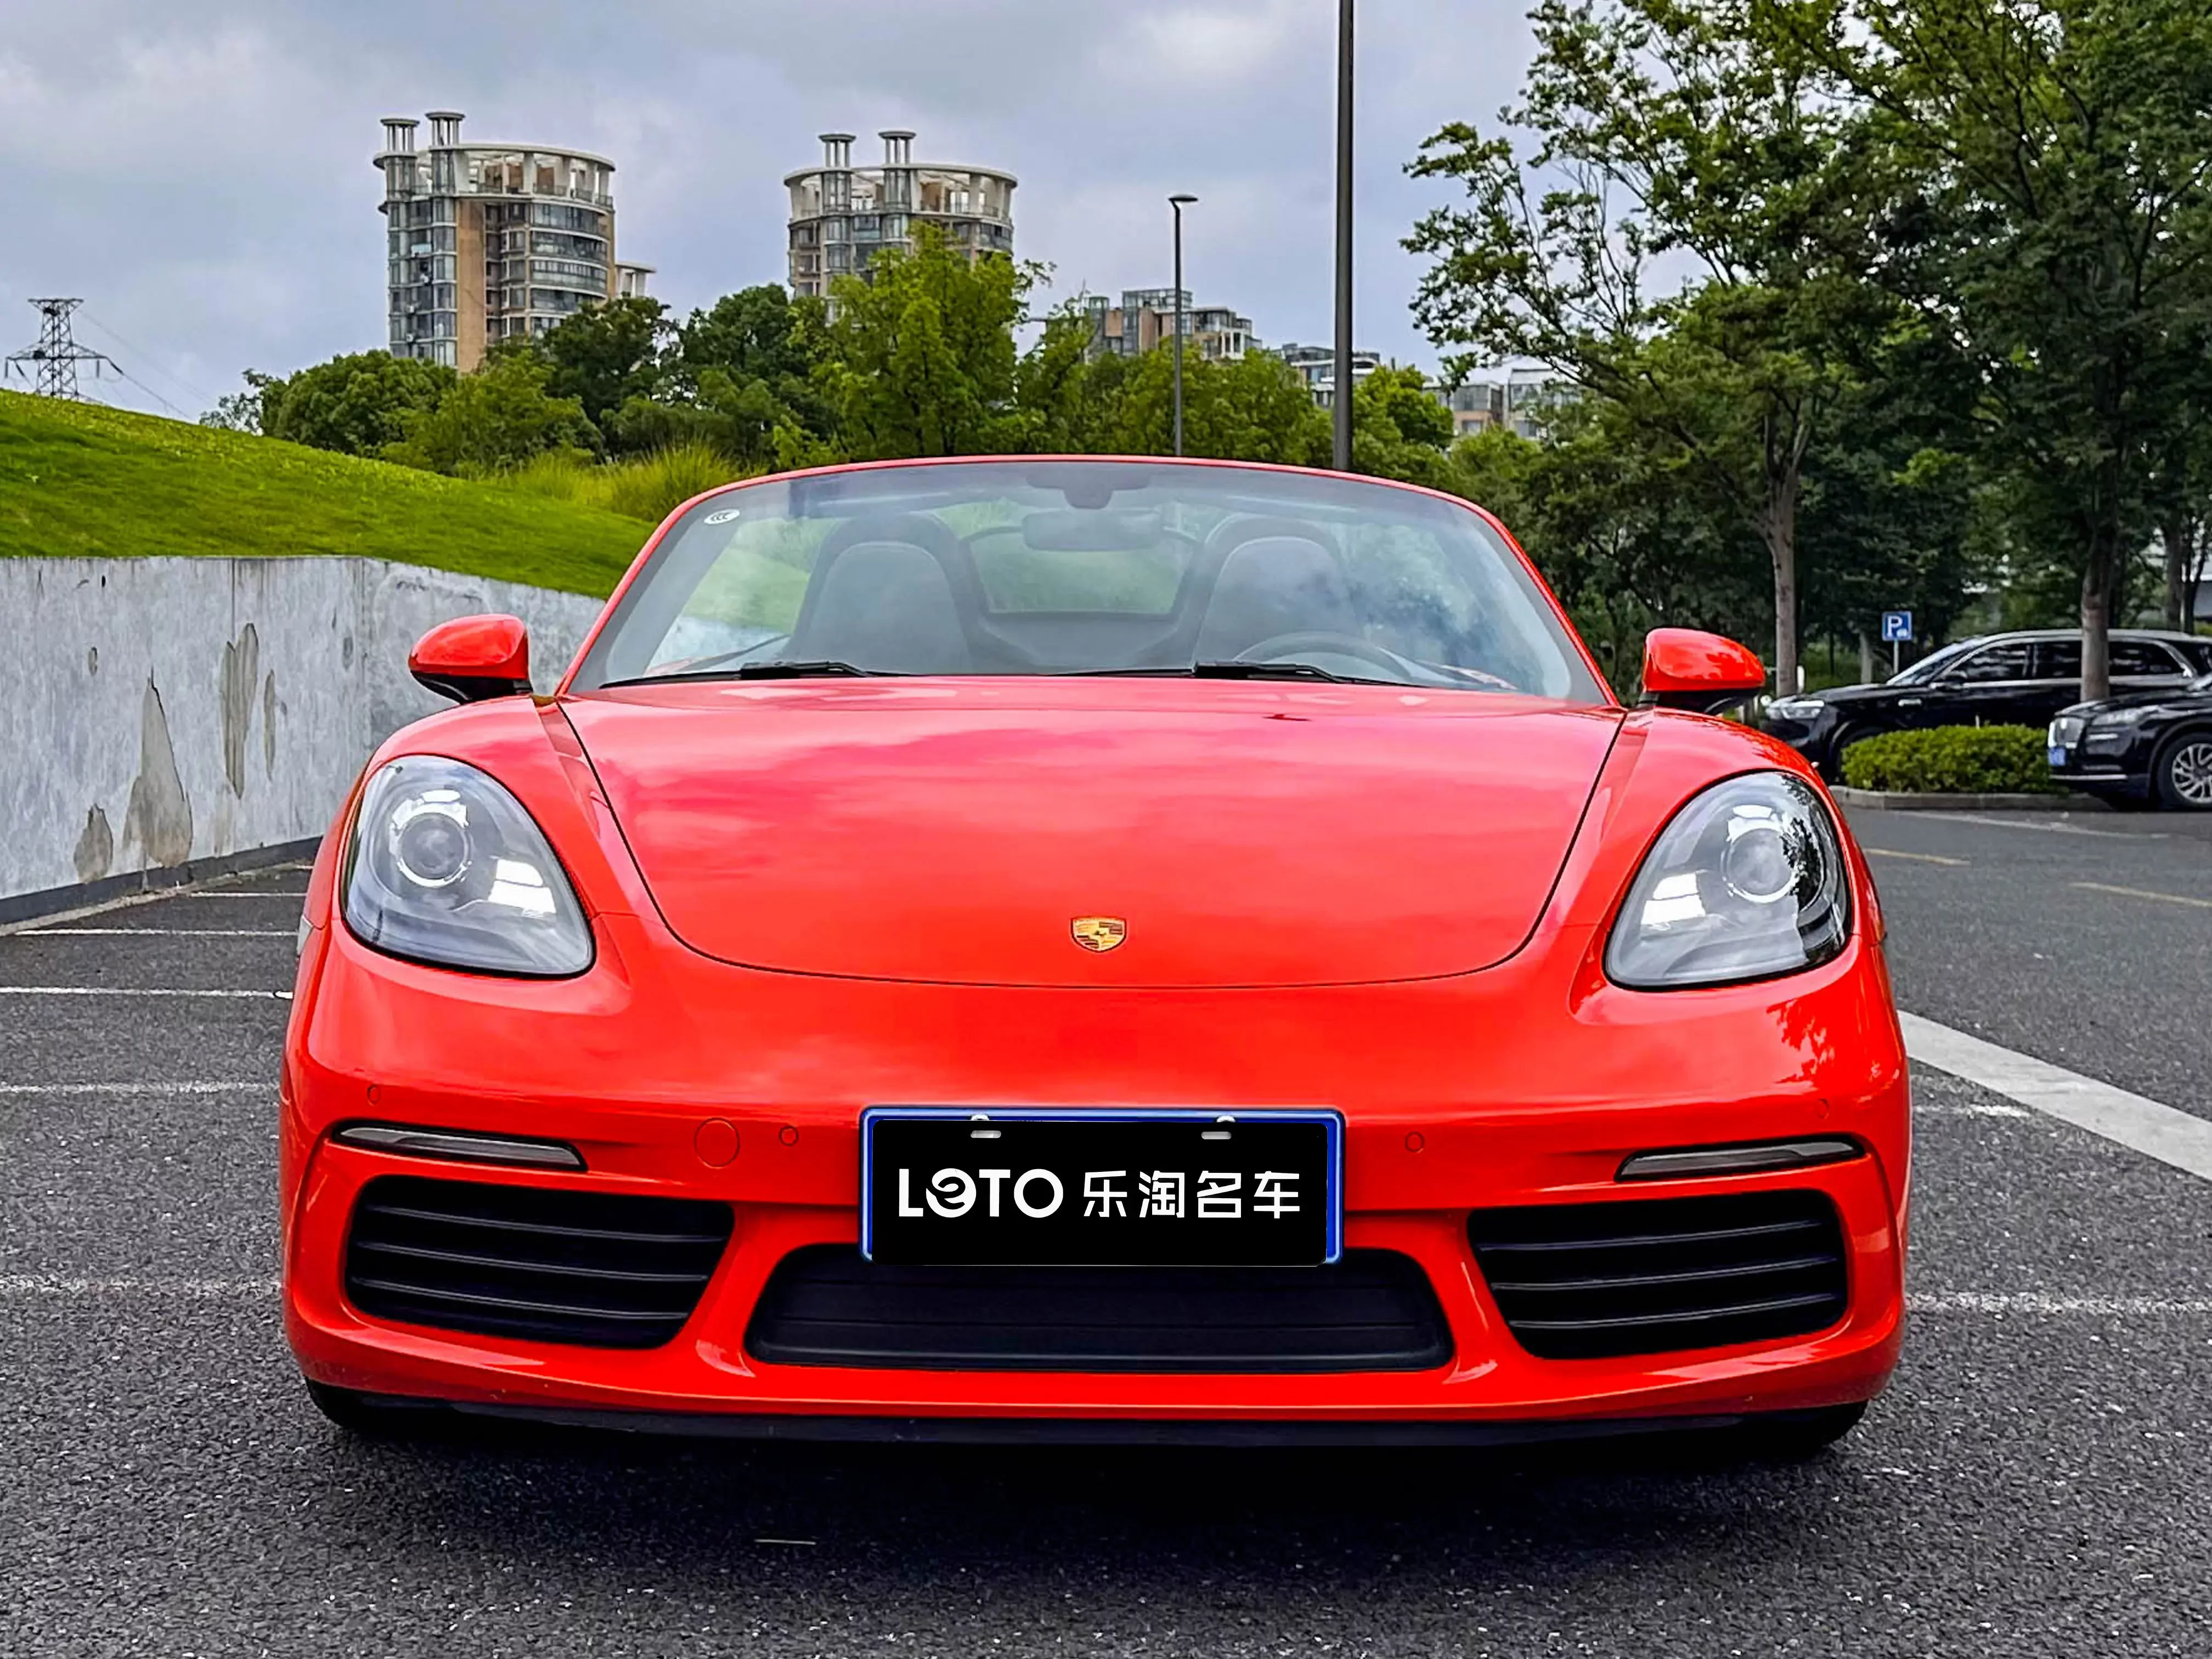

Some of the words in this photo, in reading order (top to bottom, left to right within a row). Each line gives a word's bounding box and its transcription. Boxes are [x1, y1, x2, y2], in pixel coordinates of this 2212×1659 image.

[1887, 616, 1903, 637] P
[899, 1168, 1064, 1218] LOTO
[1084, 1170, 1300, 1219] 乐淘名车
